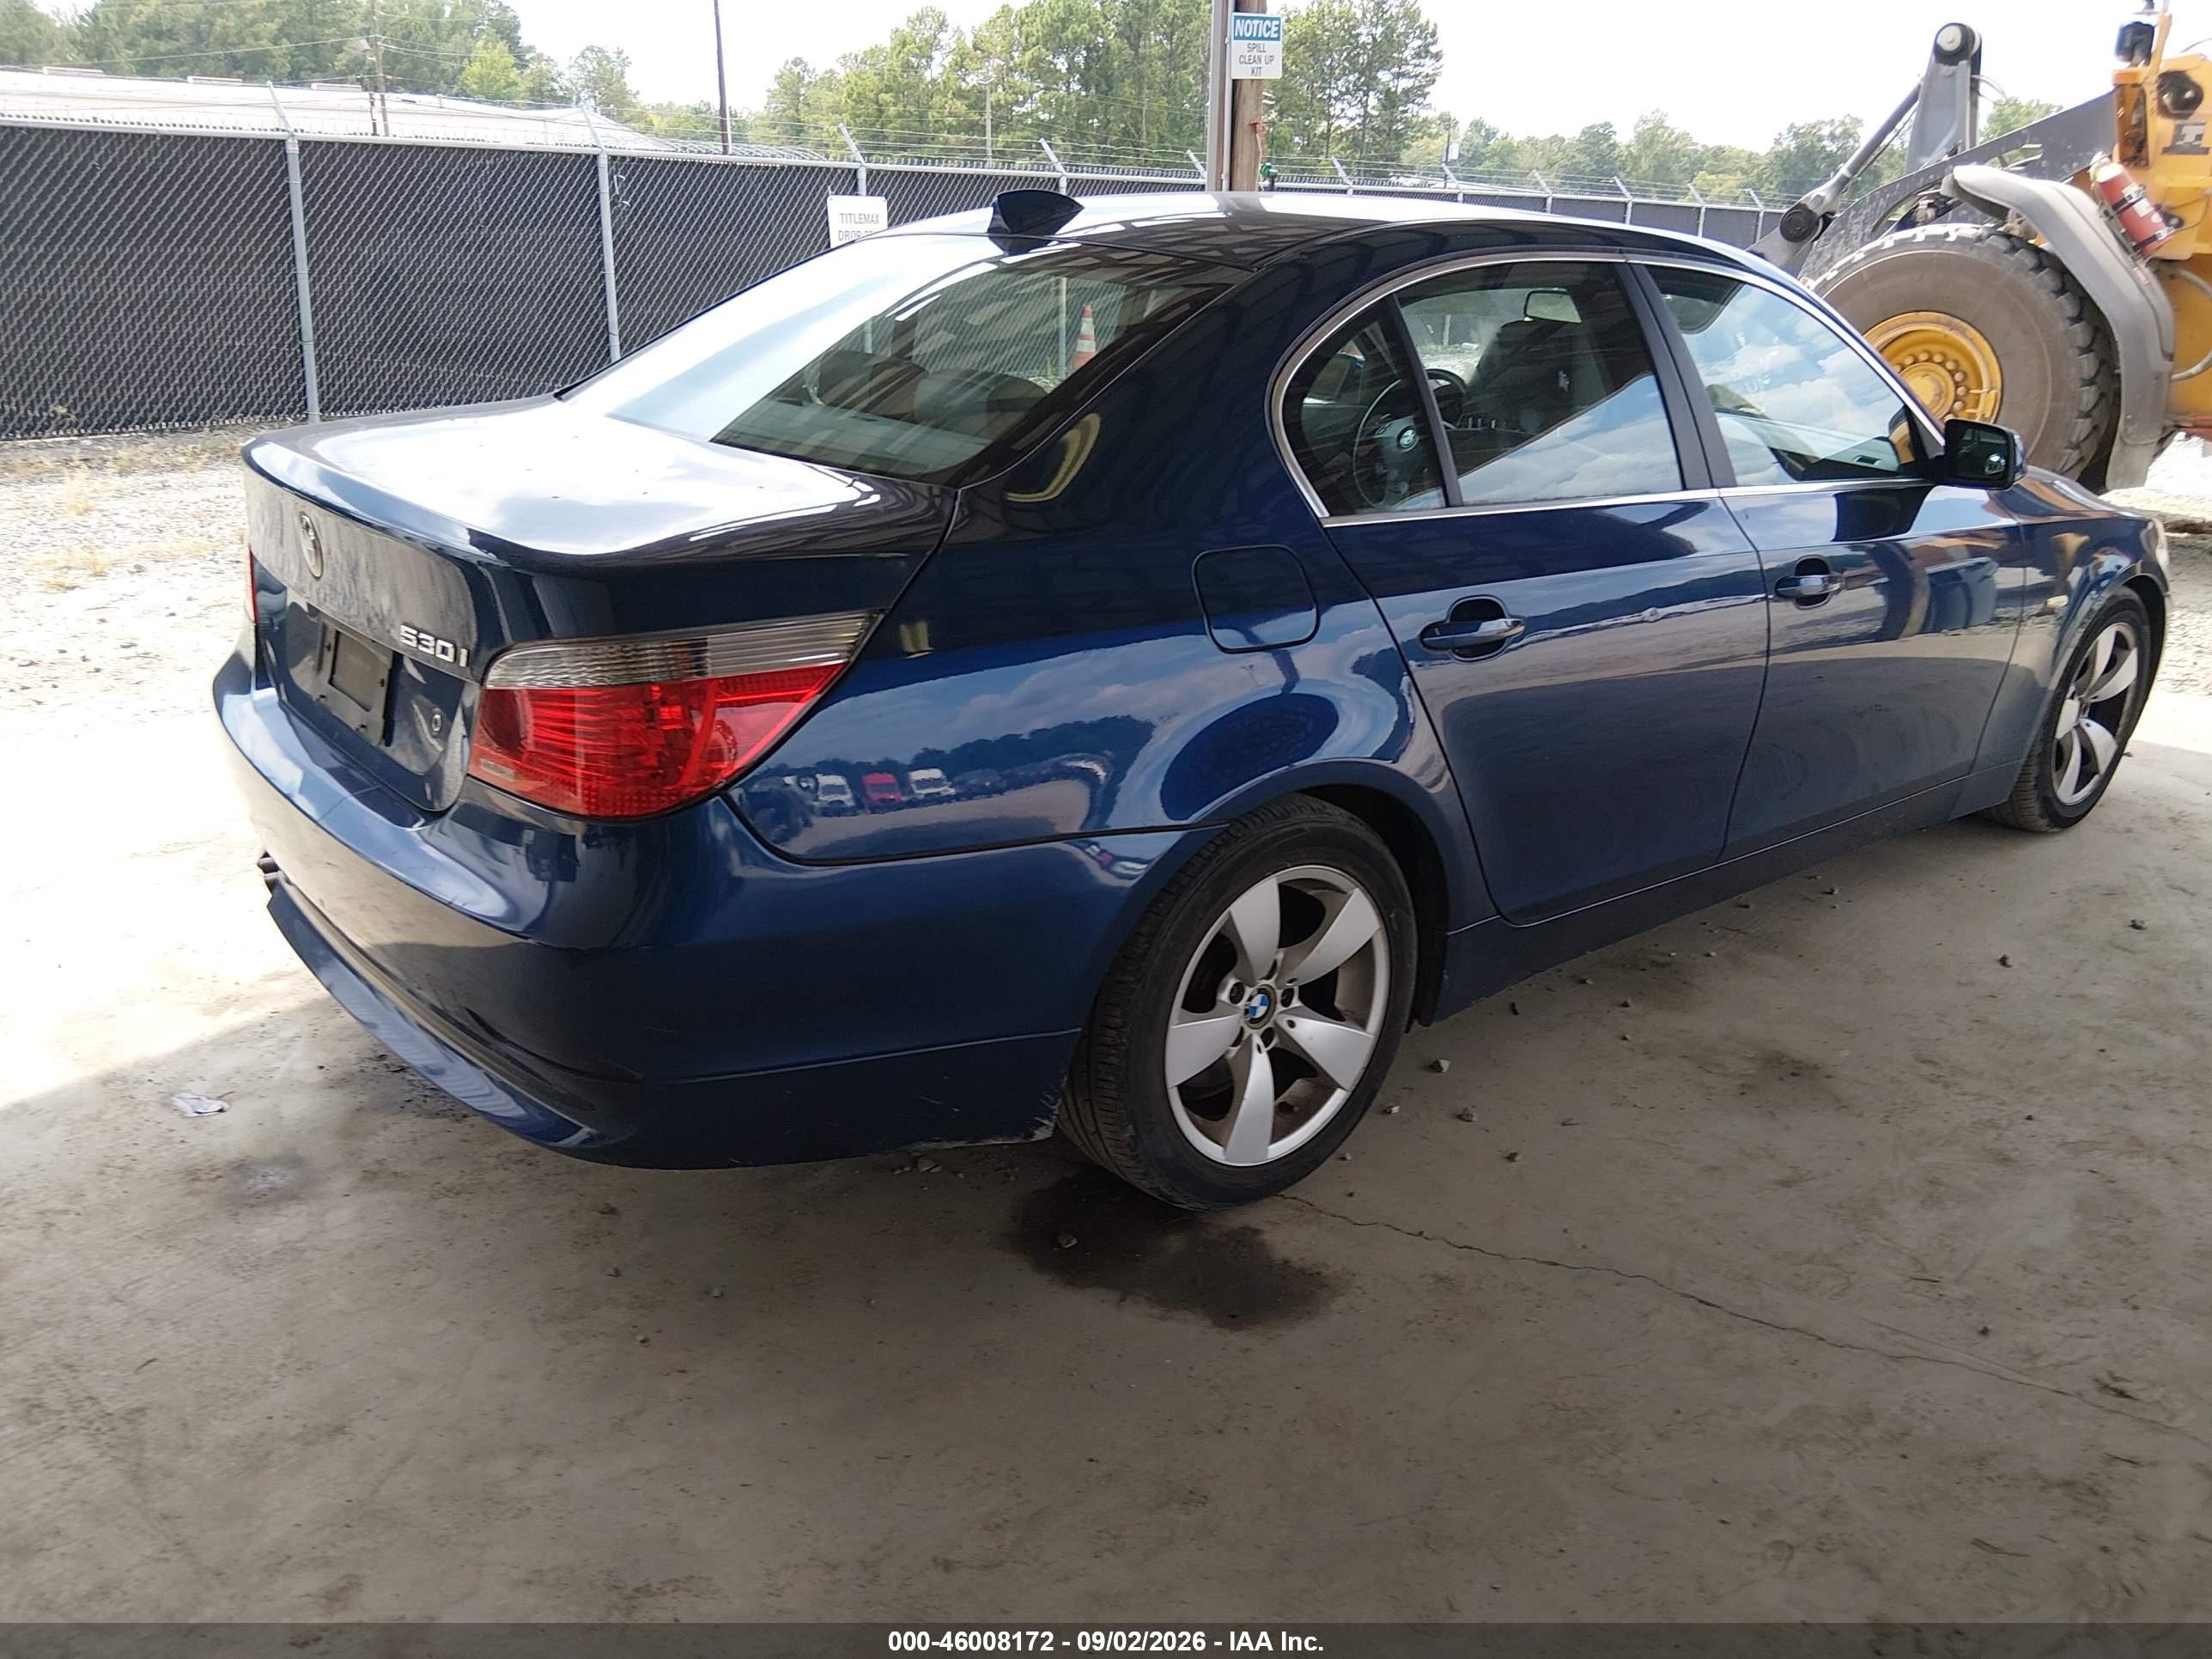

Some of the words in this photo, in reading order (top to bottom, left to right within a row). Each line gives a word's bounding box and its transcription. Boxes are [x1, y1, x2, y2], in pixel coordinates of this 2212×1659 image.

[1235, 19, 1279, 38] NOTICE
[1247, 43, 1267, 52] SPILL
[1239, 55, 1261, 64] CLEAN
[1265, 55, 1274, 64] UP
[1251, 67, 1262, 76] KIT
[839, 213, 879, 224] TITLEMAX
